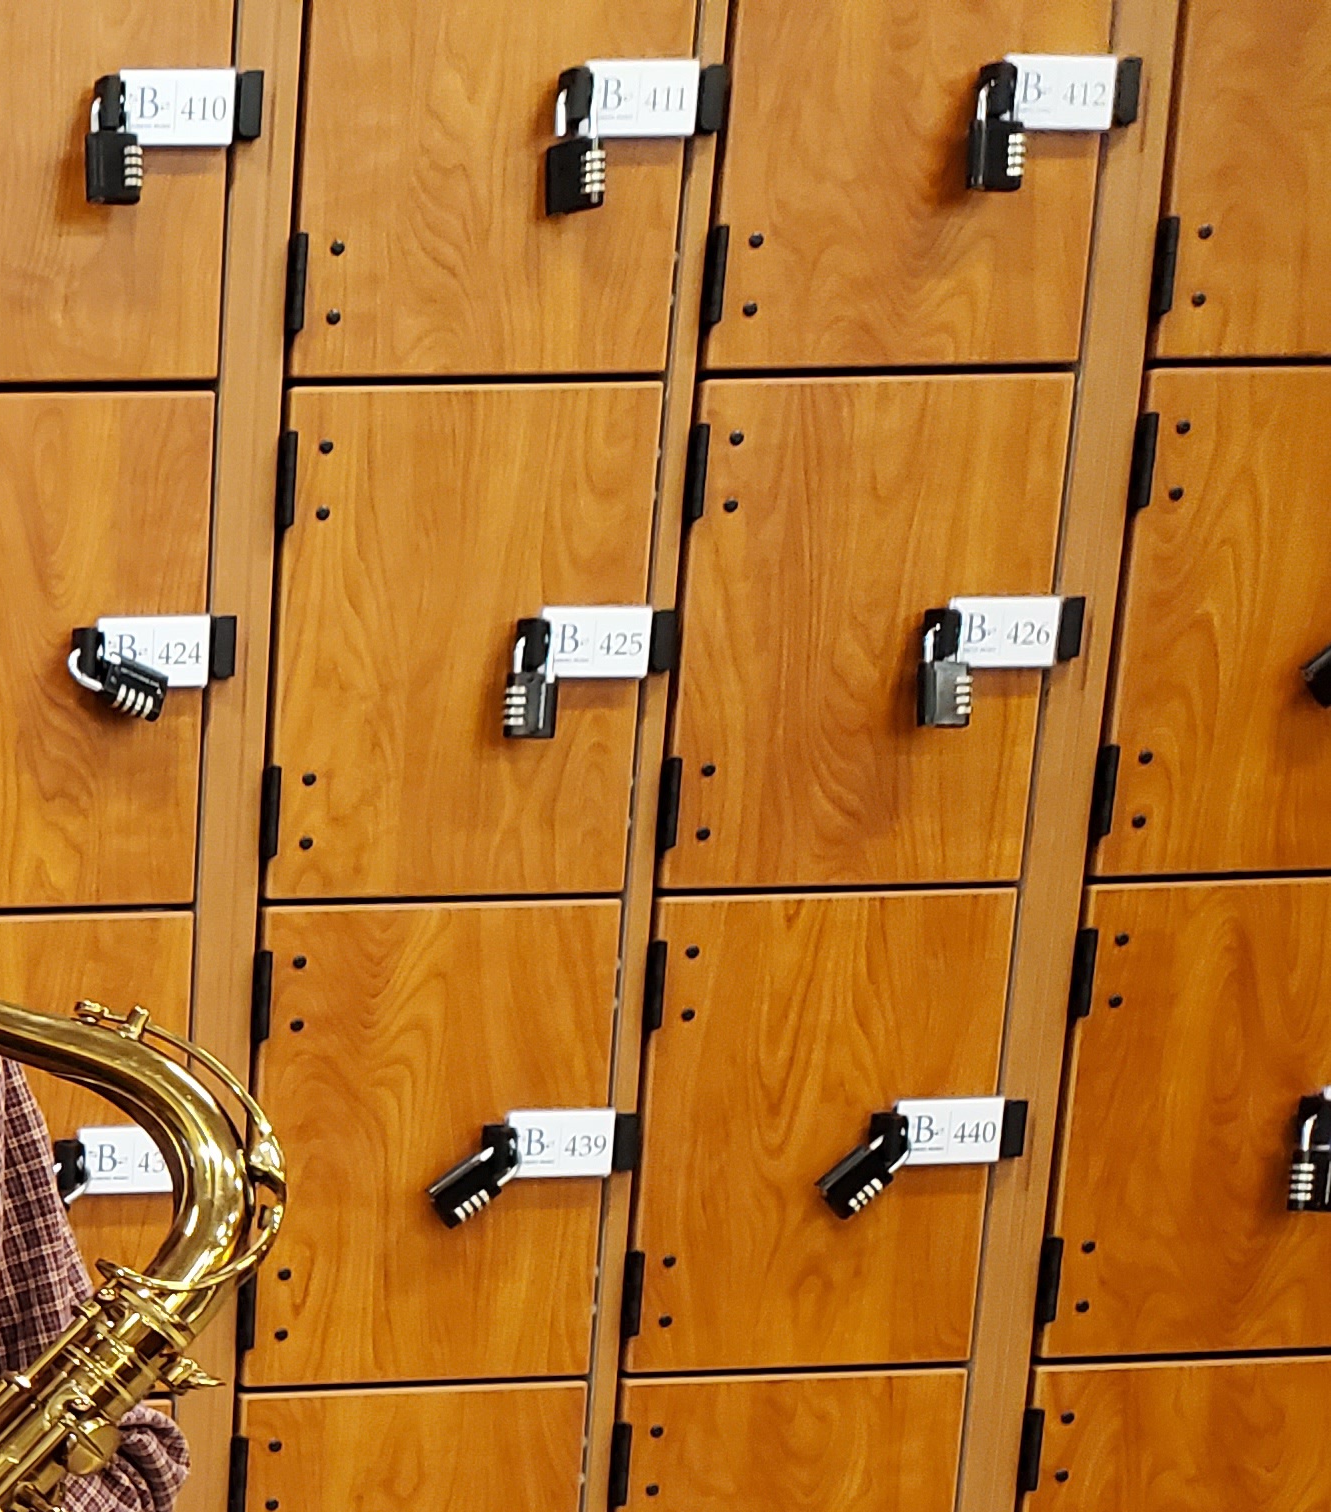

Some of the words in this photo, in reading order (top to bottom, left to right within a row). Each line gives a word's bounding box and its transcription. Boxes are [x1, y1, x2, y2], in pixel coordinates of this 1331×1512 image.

[139, 88, 159, 118] B
[181, 97, 226, 120] 410
[601, 79, 621, 110] B
[645, 87, 684, 111] 411
[1020, 72, 1041, 103] B
[1063, 82, 1106, 106] 412
[558, 624, 579, 653] B
[600, 633, 642, 656] 425
[966, 614, 987, 642] B
[1007, 622, 1050, 645] 426
[116, 634, 137, 661] B
[158, 642, 201, 664] 424
[525, 1128, 545, 1155] B
[565, 1136, 606, 1157] 439
[914, 1115, 937, 1143] B
[953, 1122, 996, 1143] 440
[98, 1144, 117, 1172] B
[138, 1151, 166, 1173] 43
